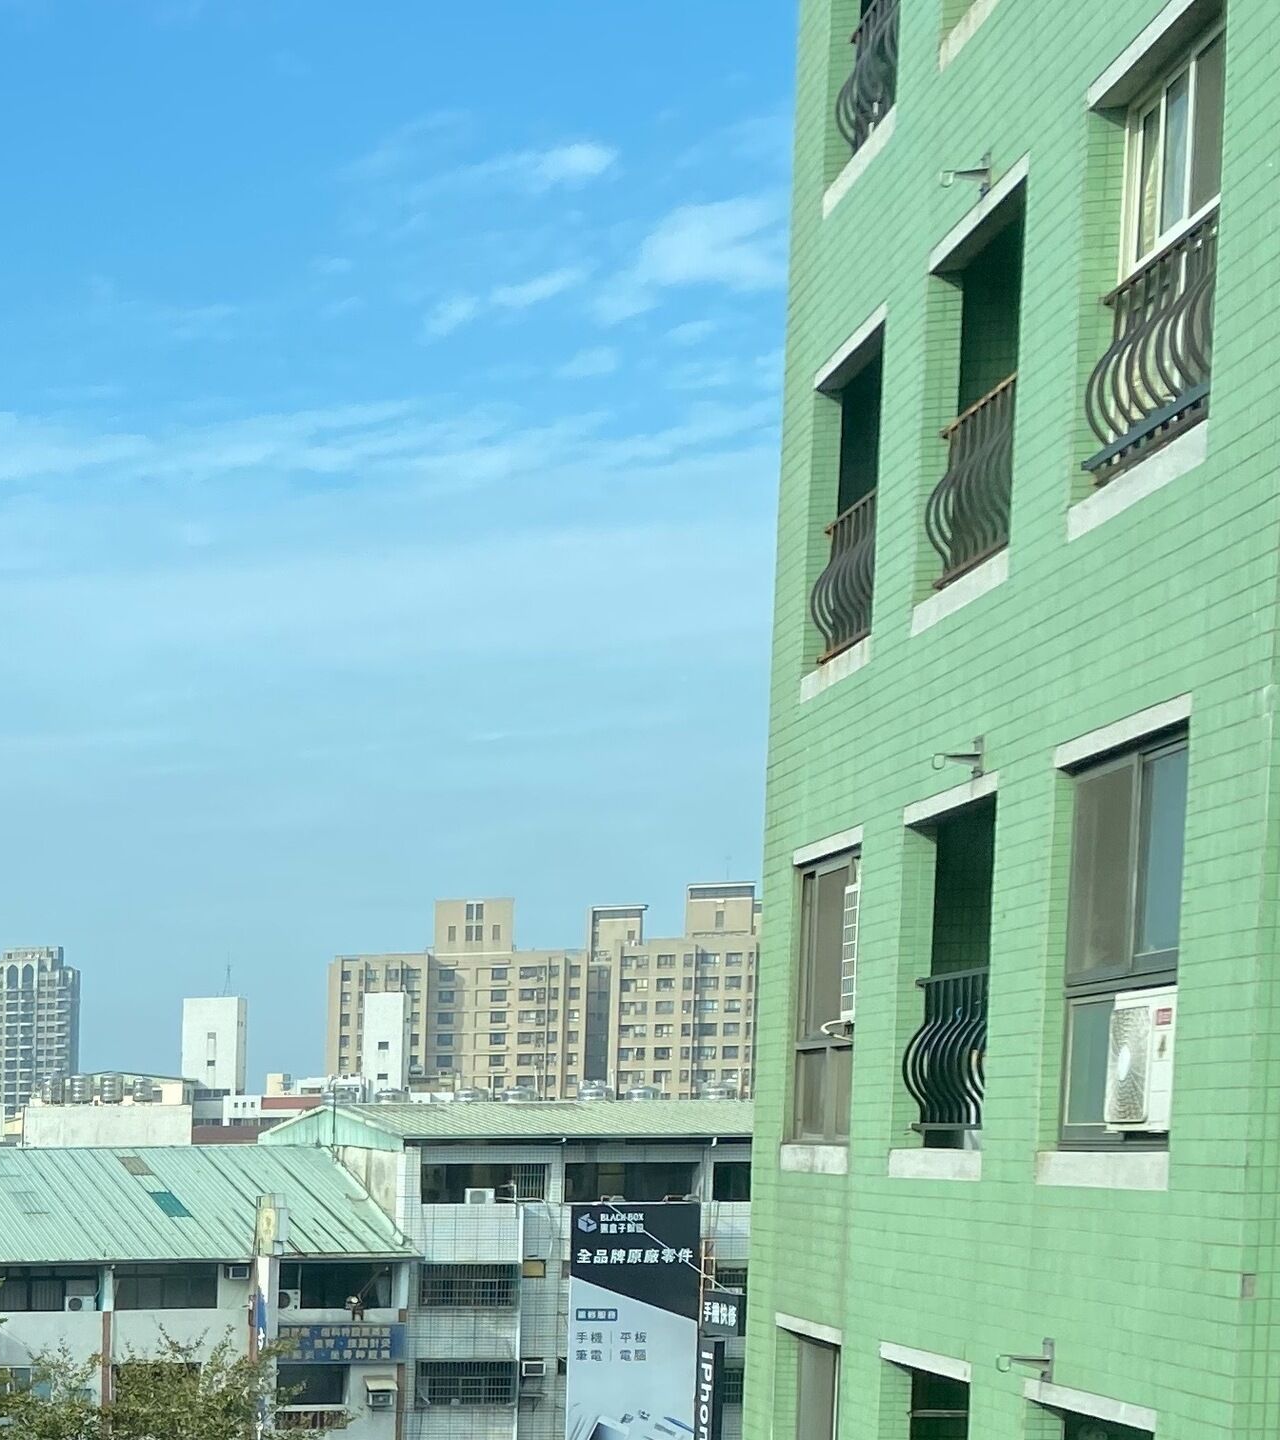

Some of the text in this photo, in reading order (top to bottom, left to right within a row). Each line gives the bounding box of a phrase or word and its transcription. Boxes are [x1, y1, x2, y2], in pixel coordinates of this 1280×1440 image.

[577, 1248, 693, 1264] 全品牌原廠零件
